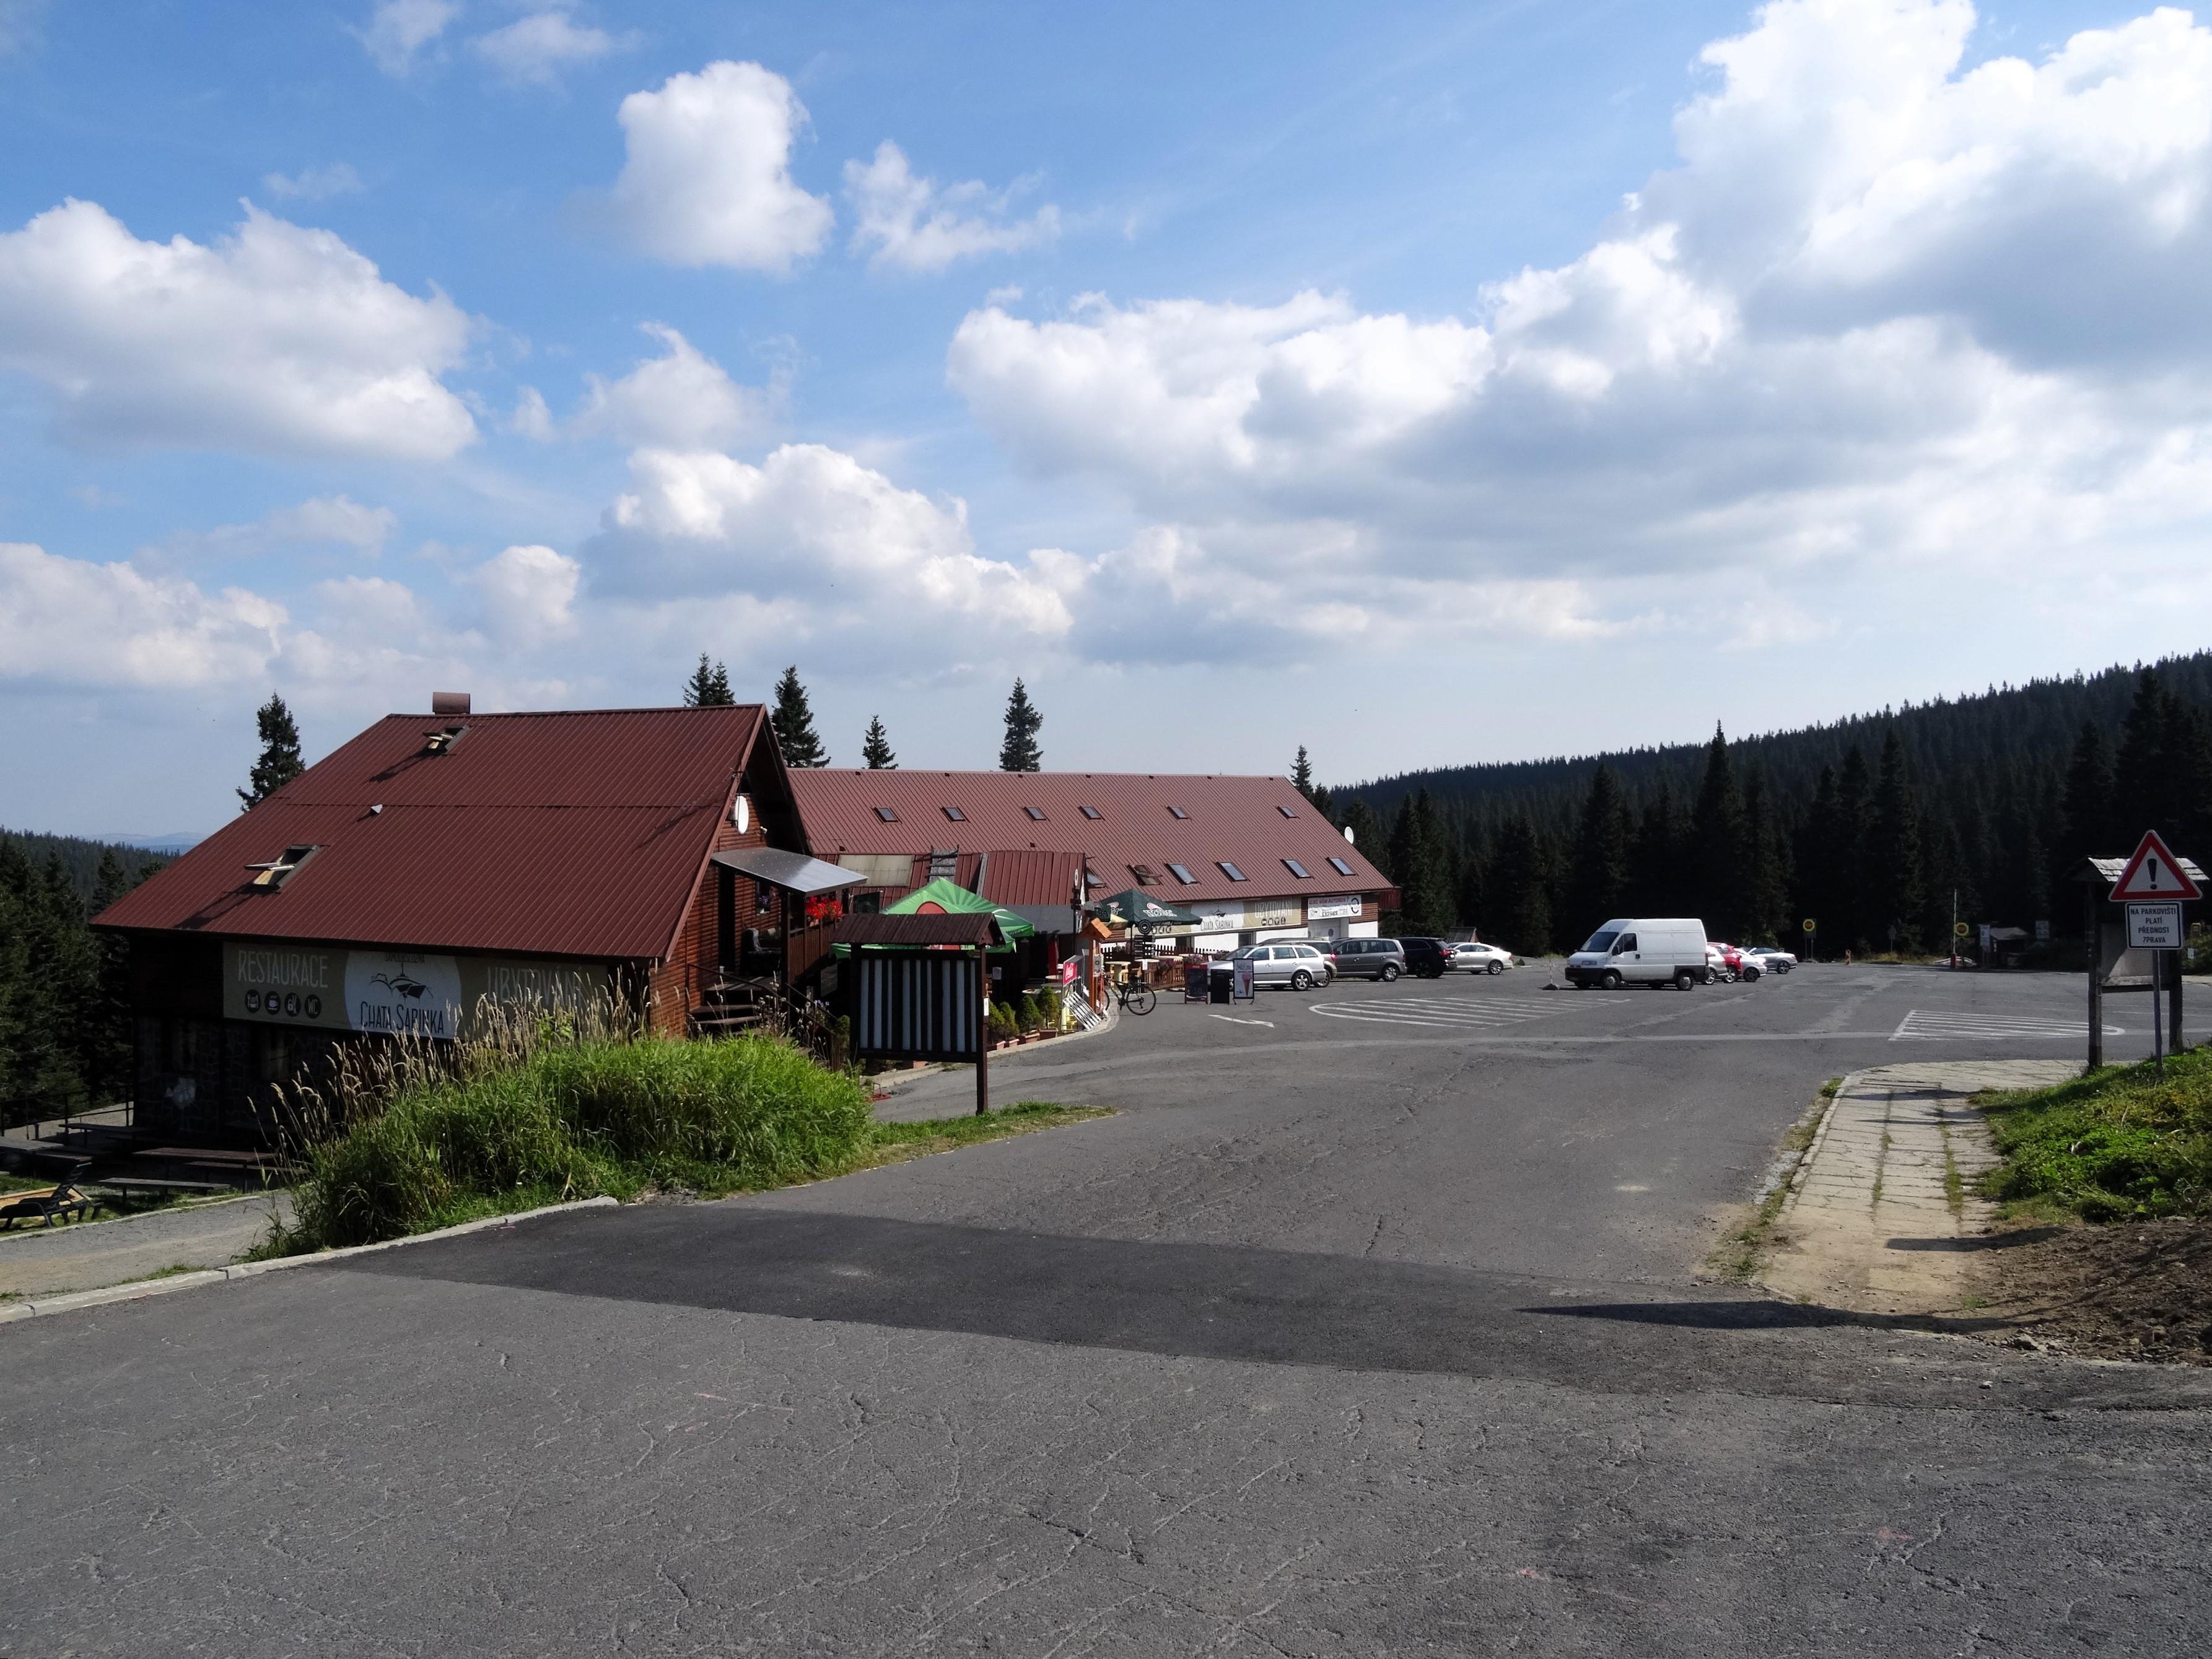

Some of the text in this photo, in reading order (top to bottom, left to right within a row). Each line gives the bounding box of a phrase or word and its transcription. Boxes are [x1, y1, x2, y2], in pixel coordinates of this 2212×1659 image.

[2141, 907, 2176, 915] PARKOVIŠTI
[2145, 916, 2162, 924] PLATÍ
[238, 950, 328, 988] RESTAURACE
[307, 998, 318, 1015] WC
[361, 1001, 391, 1030] CHATA
